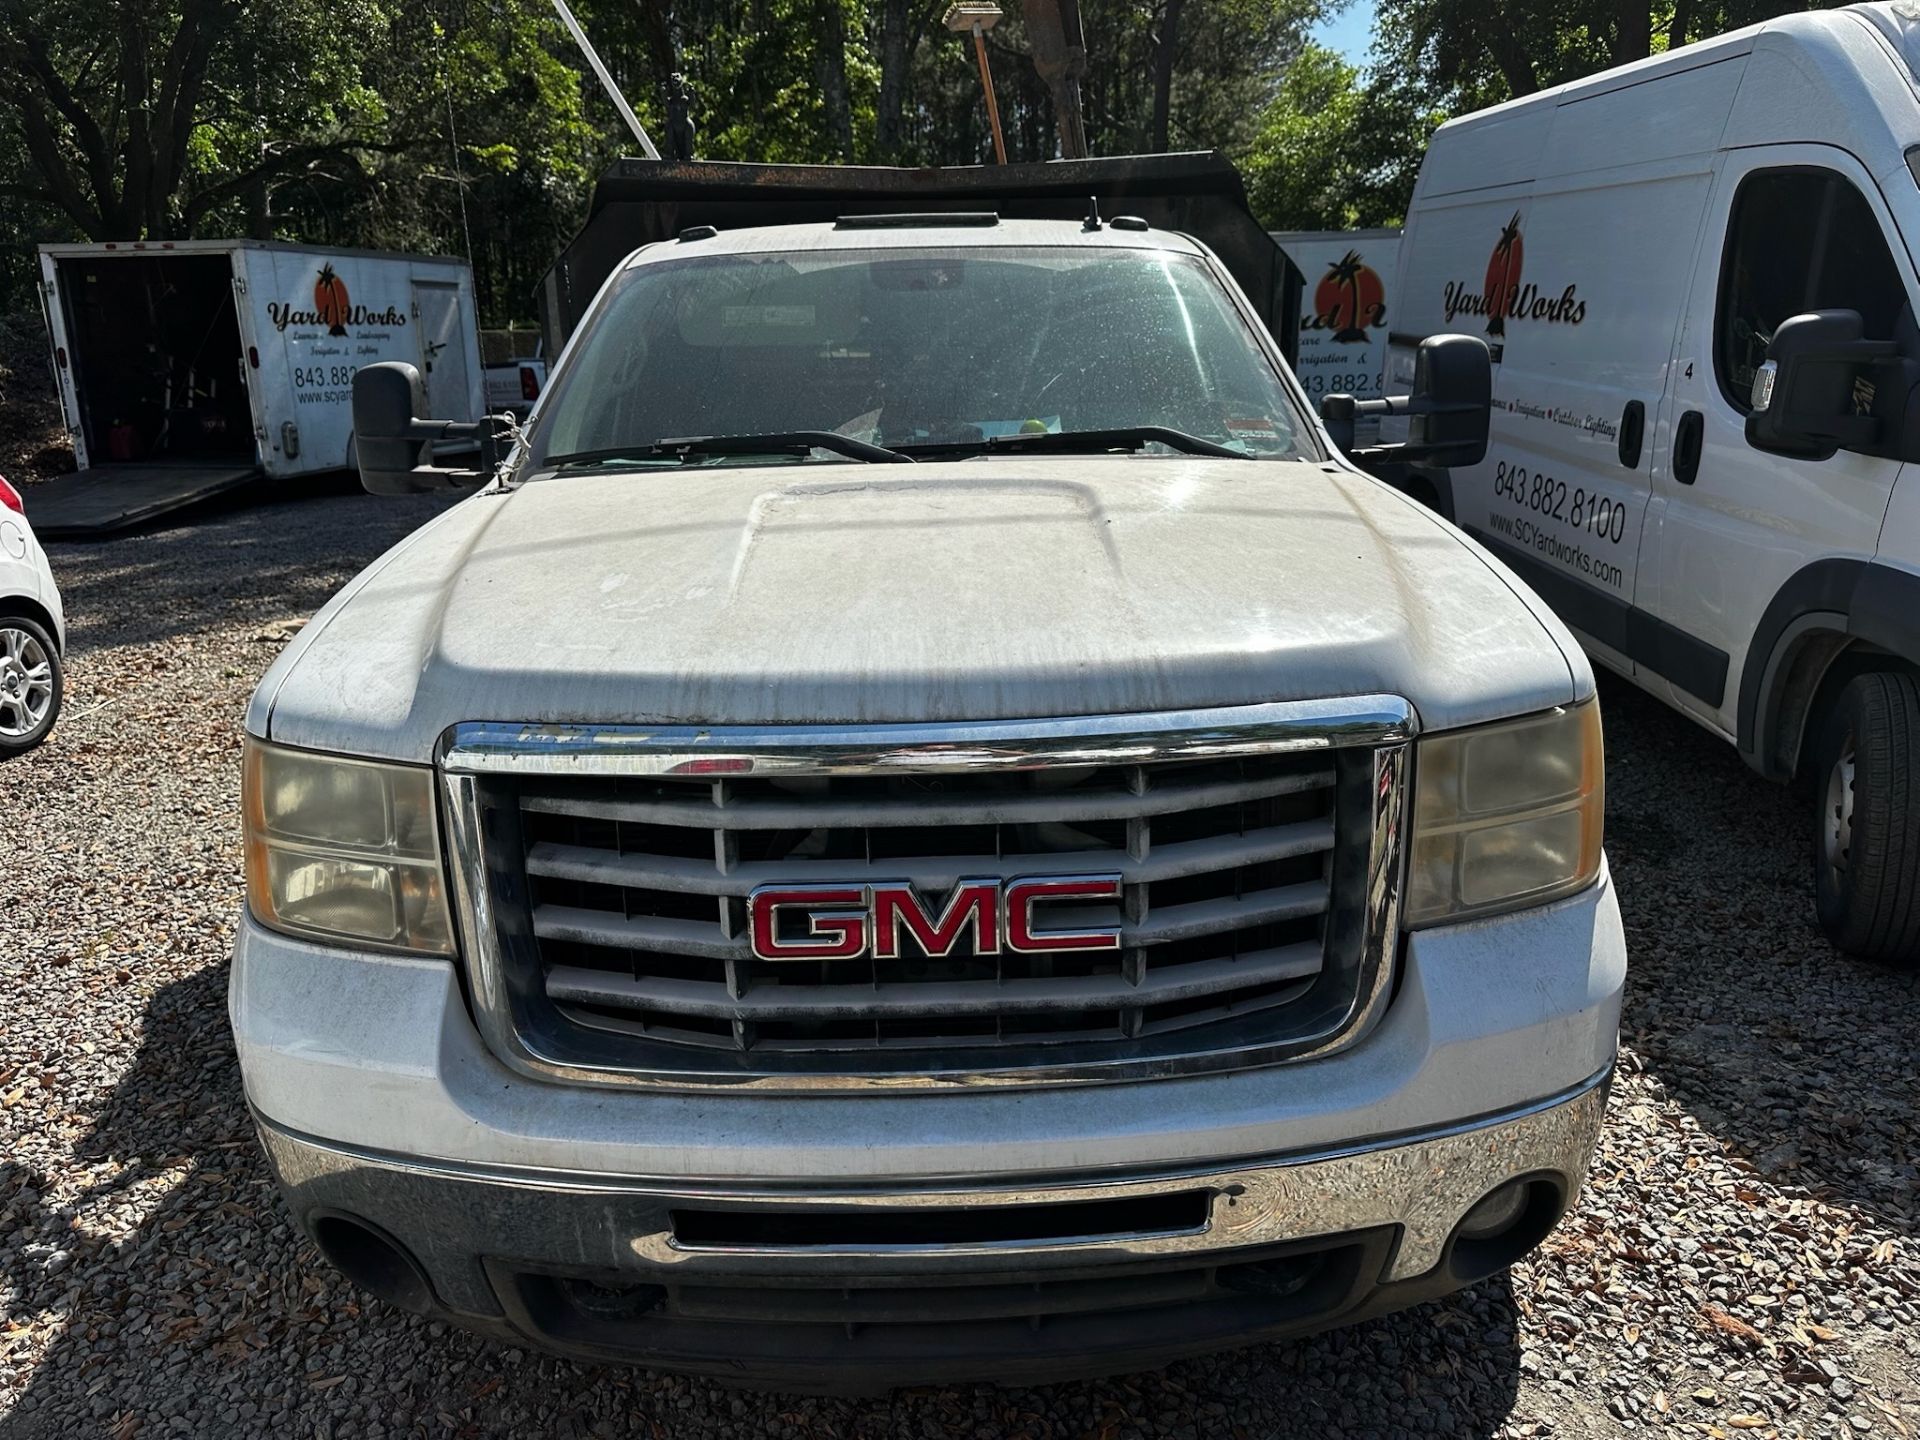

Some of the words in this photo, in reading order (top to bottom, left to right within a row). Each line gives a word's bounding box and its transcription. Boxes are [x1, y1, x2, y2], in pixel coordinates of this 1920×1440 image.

[267, 302, 331, 331] Yard
[343, 305, 406, 326] Works
[1444, 281, 1496, 322] Yard
[1508, 284, 1586, 324] Works
[1357, 353, 1368, 365] &
[1685, 363, 1693, 379] 4
[1584, 414, 1616, 442] Lighting
[1494, 461, 1625, 544] 843.882.8100
[1490, 511, 1622, 588] www.SCYardworks.com
[747, 872, 1122, 962] GMC
